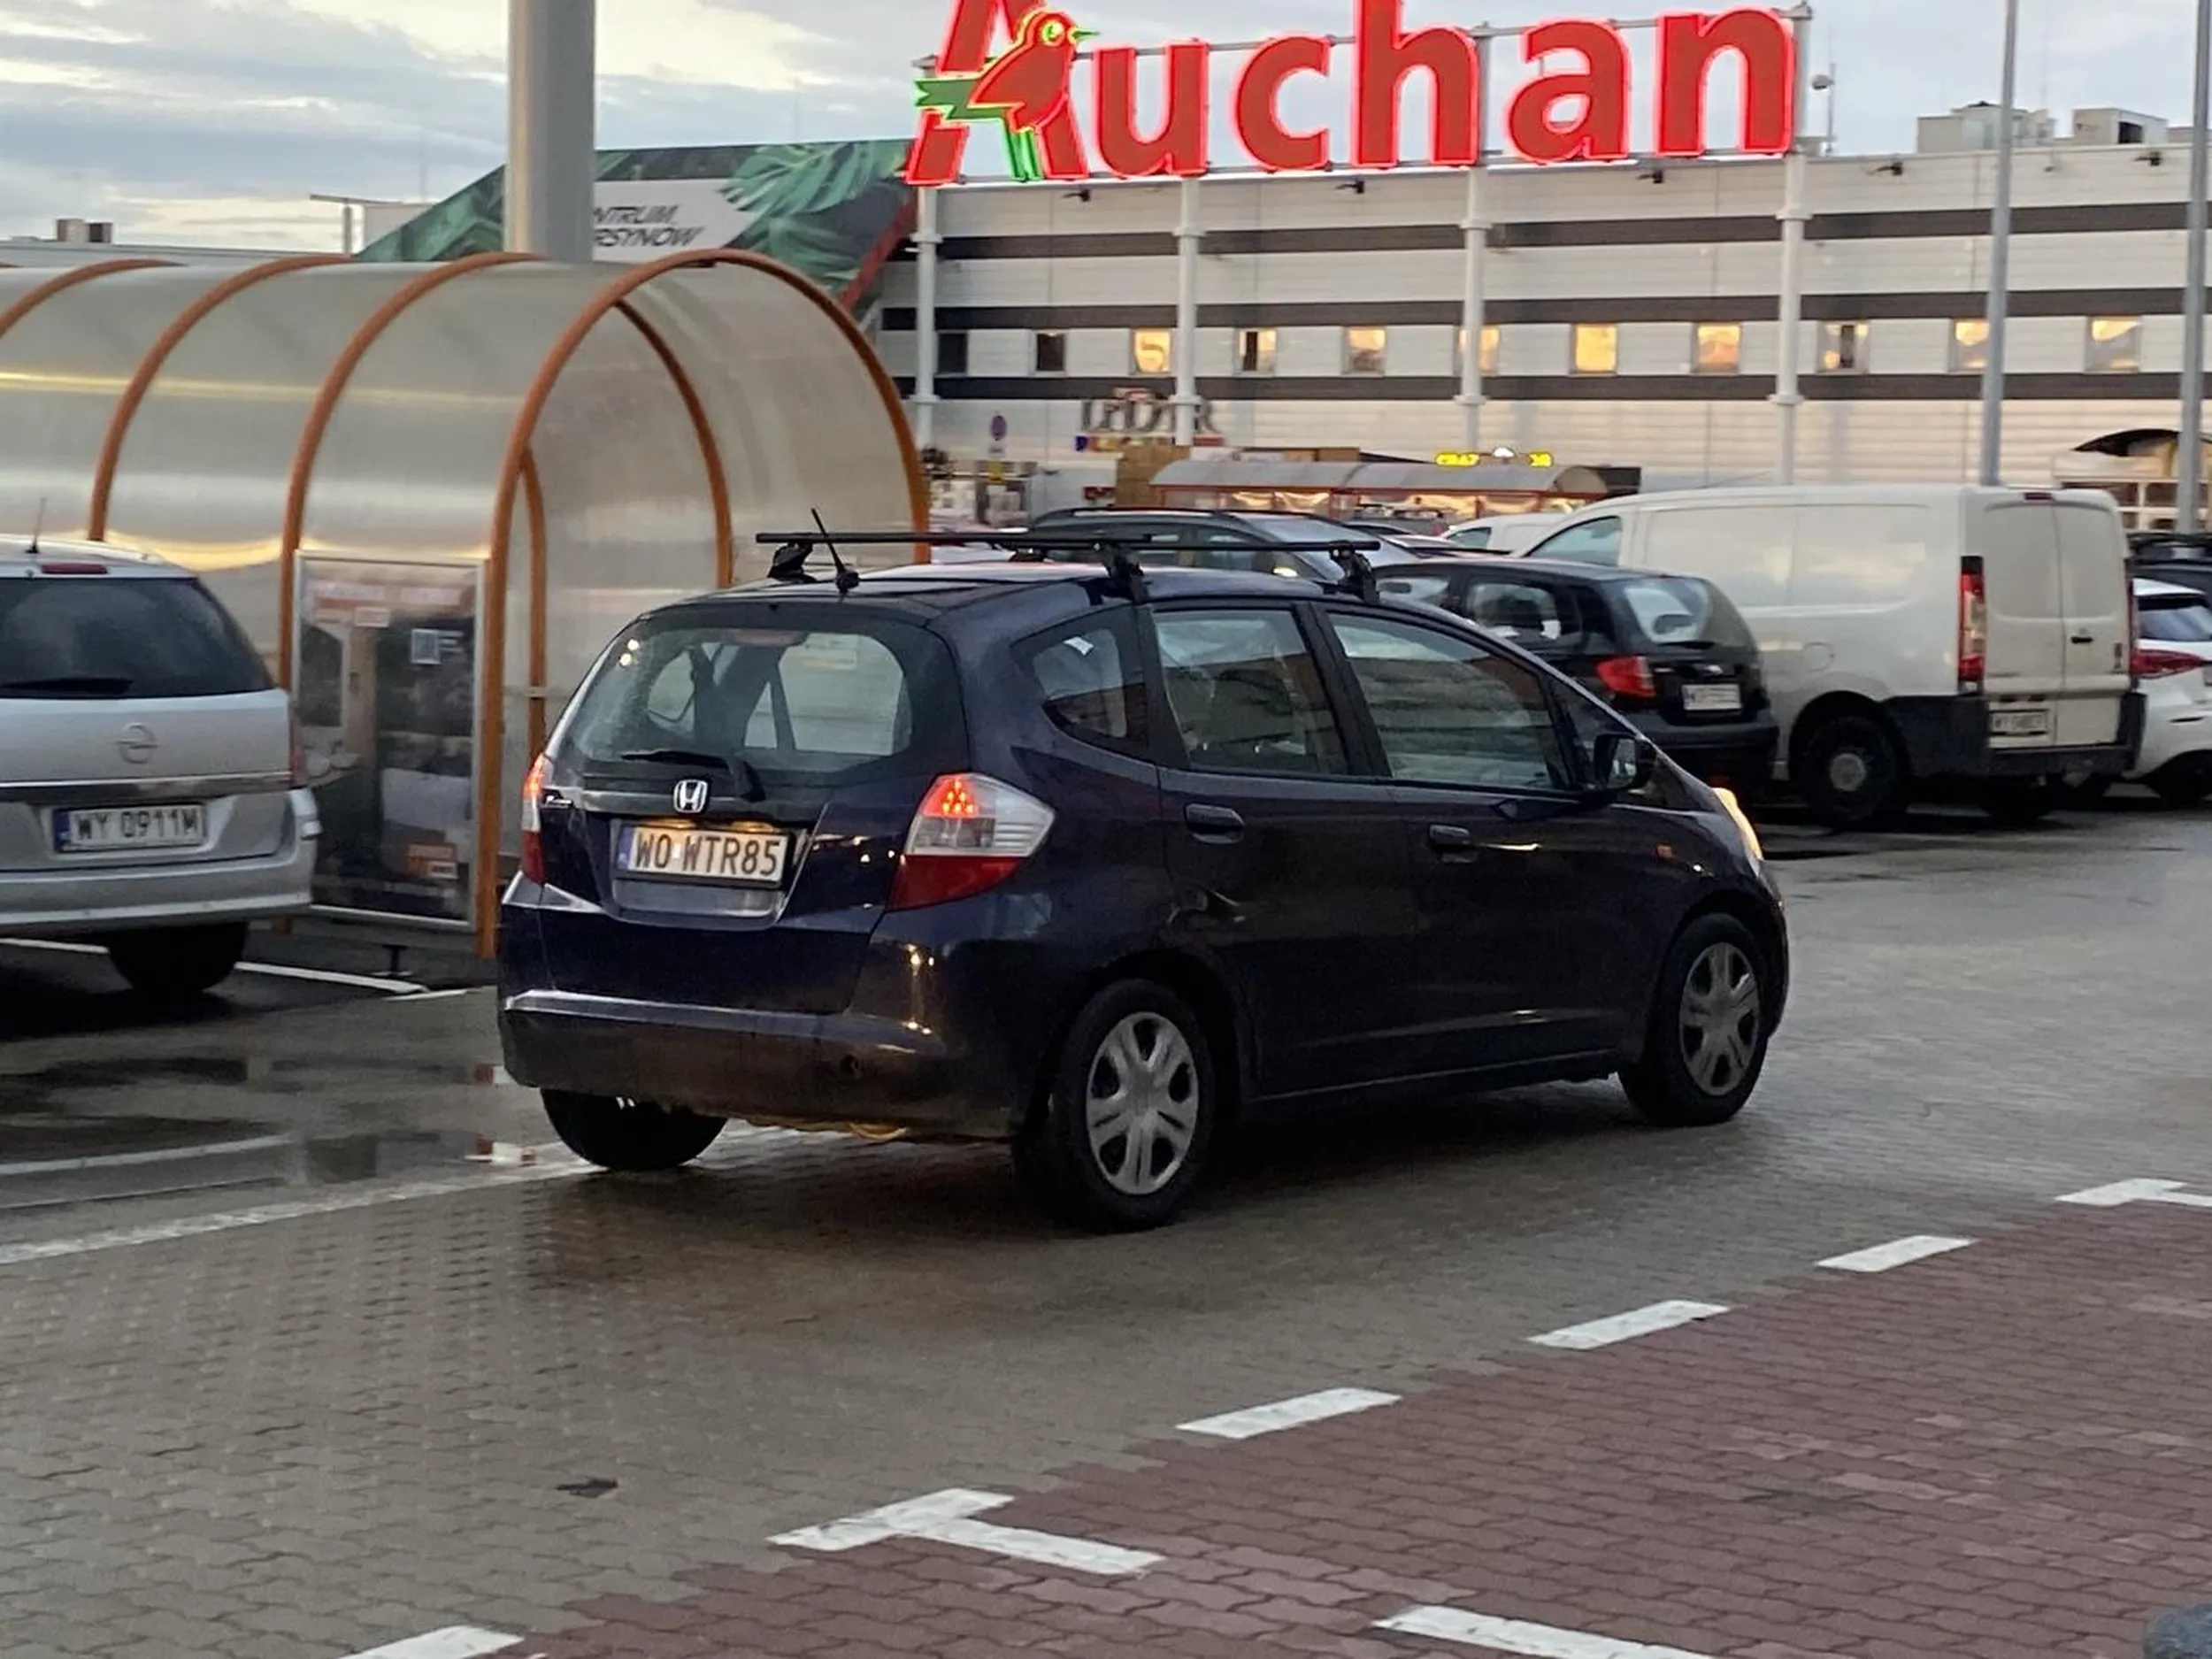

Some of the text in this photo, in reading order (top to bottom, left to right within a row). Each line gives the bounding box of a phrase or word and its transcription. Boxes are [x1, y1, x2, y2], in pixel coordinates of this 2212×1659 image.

[904, 0, 1796, 185] Auchan
[594, 204, 680, 224] NTRUM
[77, 812, 110, 840] WY
[635, 832, 780, 877] WO WTR85
